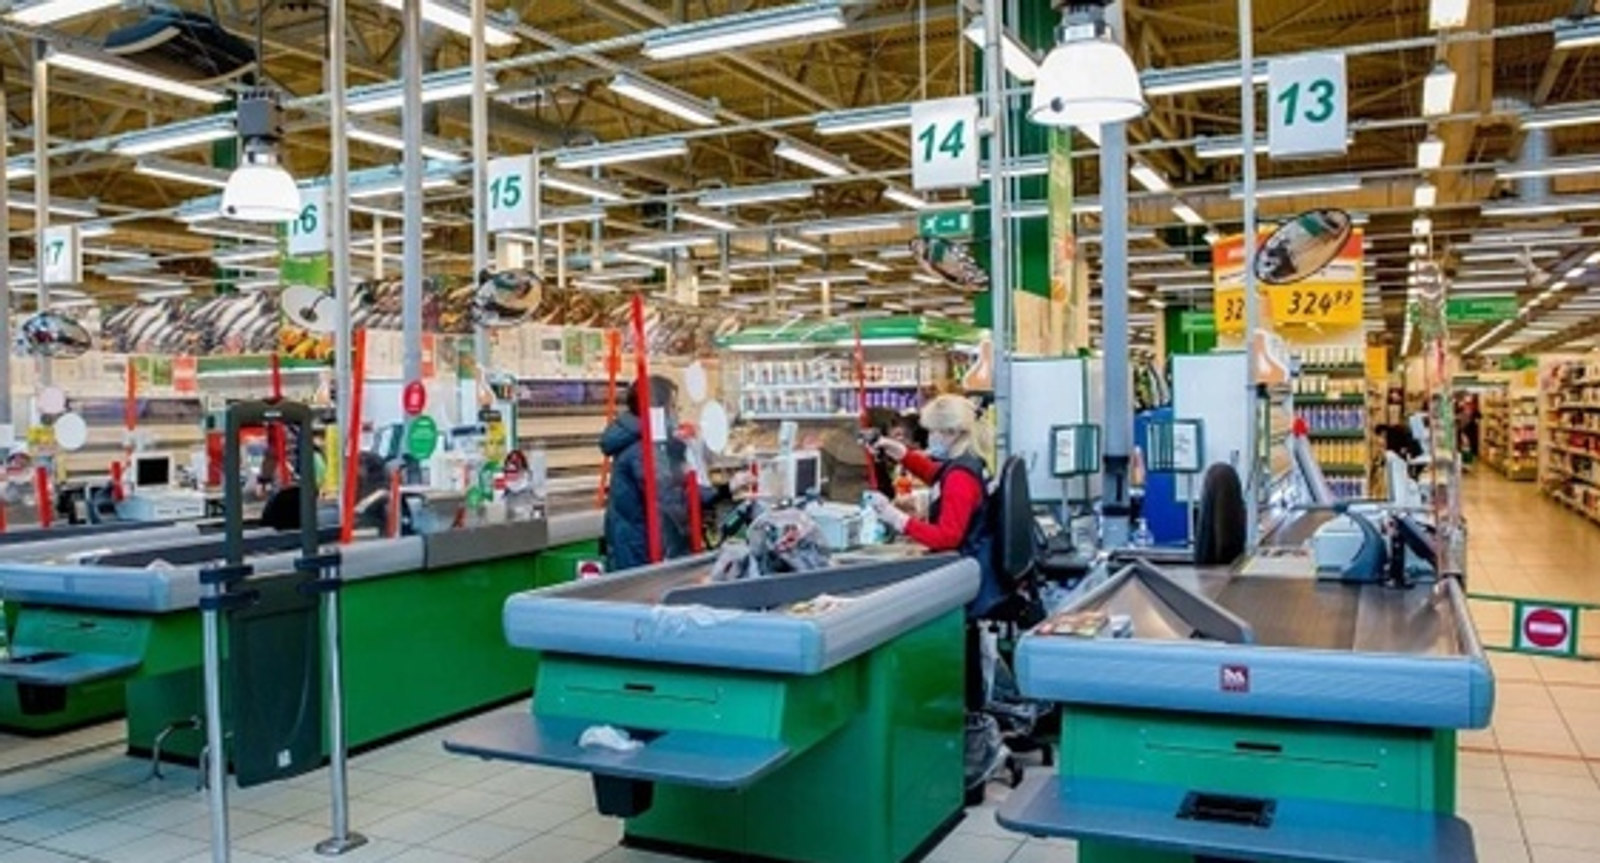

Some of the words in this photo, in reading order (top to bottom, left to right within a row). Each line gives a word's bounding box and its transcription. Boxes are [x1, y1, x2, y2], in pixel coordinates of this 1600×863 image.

[1277, 79, 1336, 126] 13
[918, 120, 965, 162] 14
[489, 174, 521, 209] 15
[1224, 296, 1245, 322] 32
